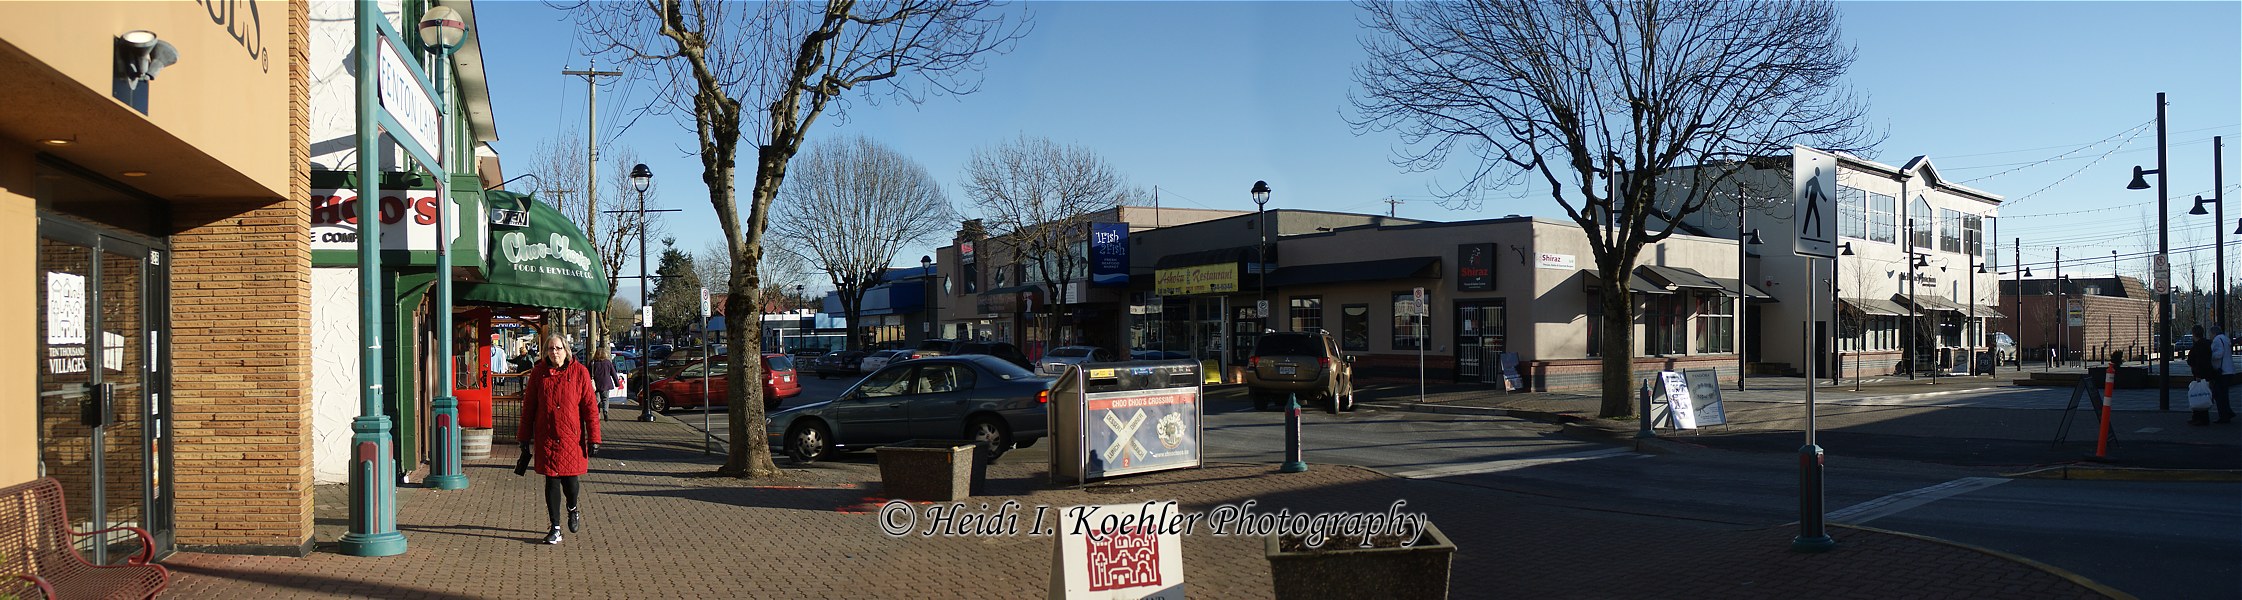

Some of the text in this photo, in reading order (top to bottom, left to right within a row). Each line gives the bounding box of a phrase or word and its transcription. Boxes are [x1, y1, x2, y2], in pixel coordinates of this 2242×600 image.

[382, 56, 436, 148] FENTON LANE
[1542, 254, 1561, 262] Shiraz
[513, 263, 536, 272] FOOD
[539, 265, 545, 273] &
[1461, 267, 1488, 277] Shiraz
[1192, 269, 1232, 283] Restaurant
[49, 347, 85, 357] TEN THOUSAND
[49, 357, 86, 374] VILLAGES
[1112, 396, 1174, 407] CHOO CHOO'S CROSSING
[1106, 414, 1123, 433] DESSERT
[1129, 413, 1144, 430] DINNER
[1107, 443, 1121, 459] LUNCH
[1124, 458, 1129, 467] 2
